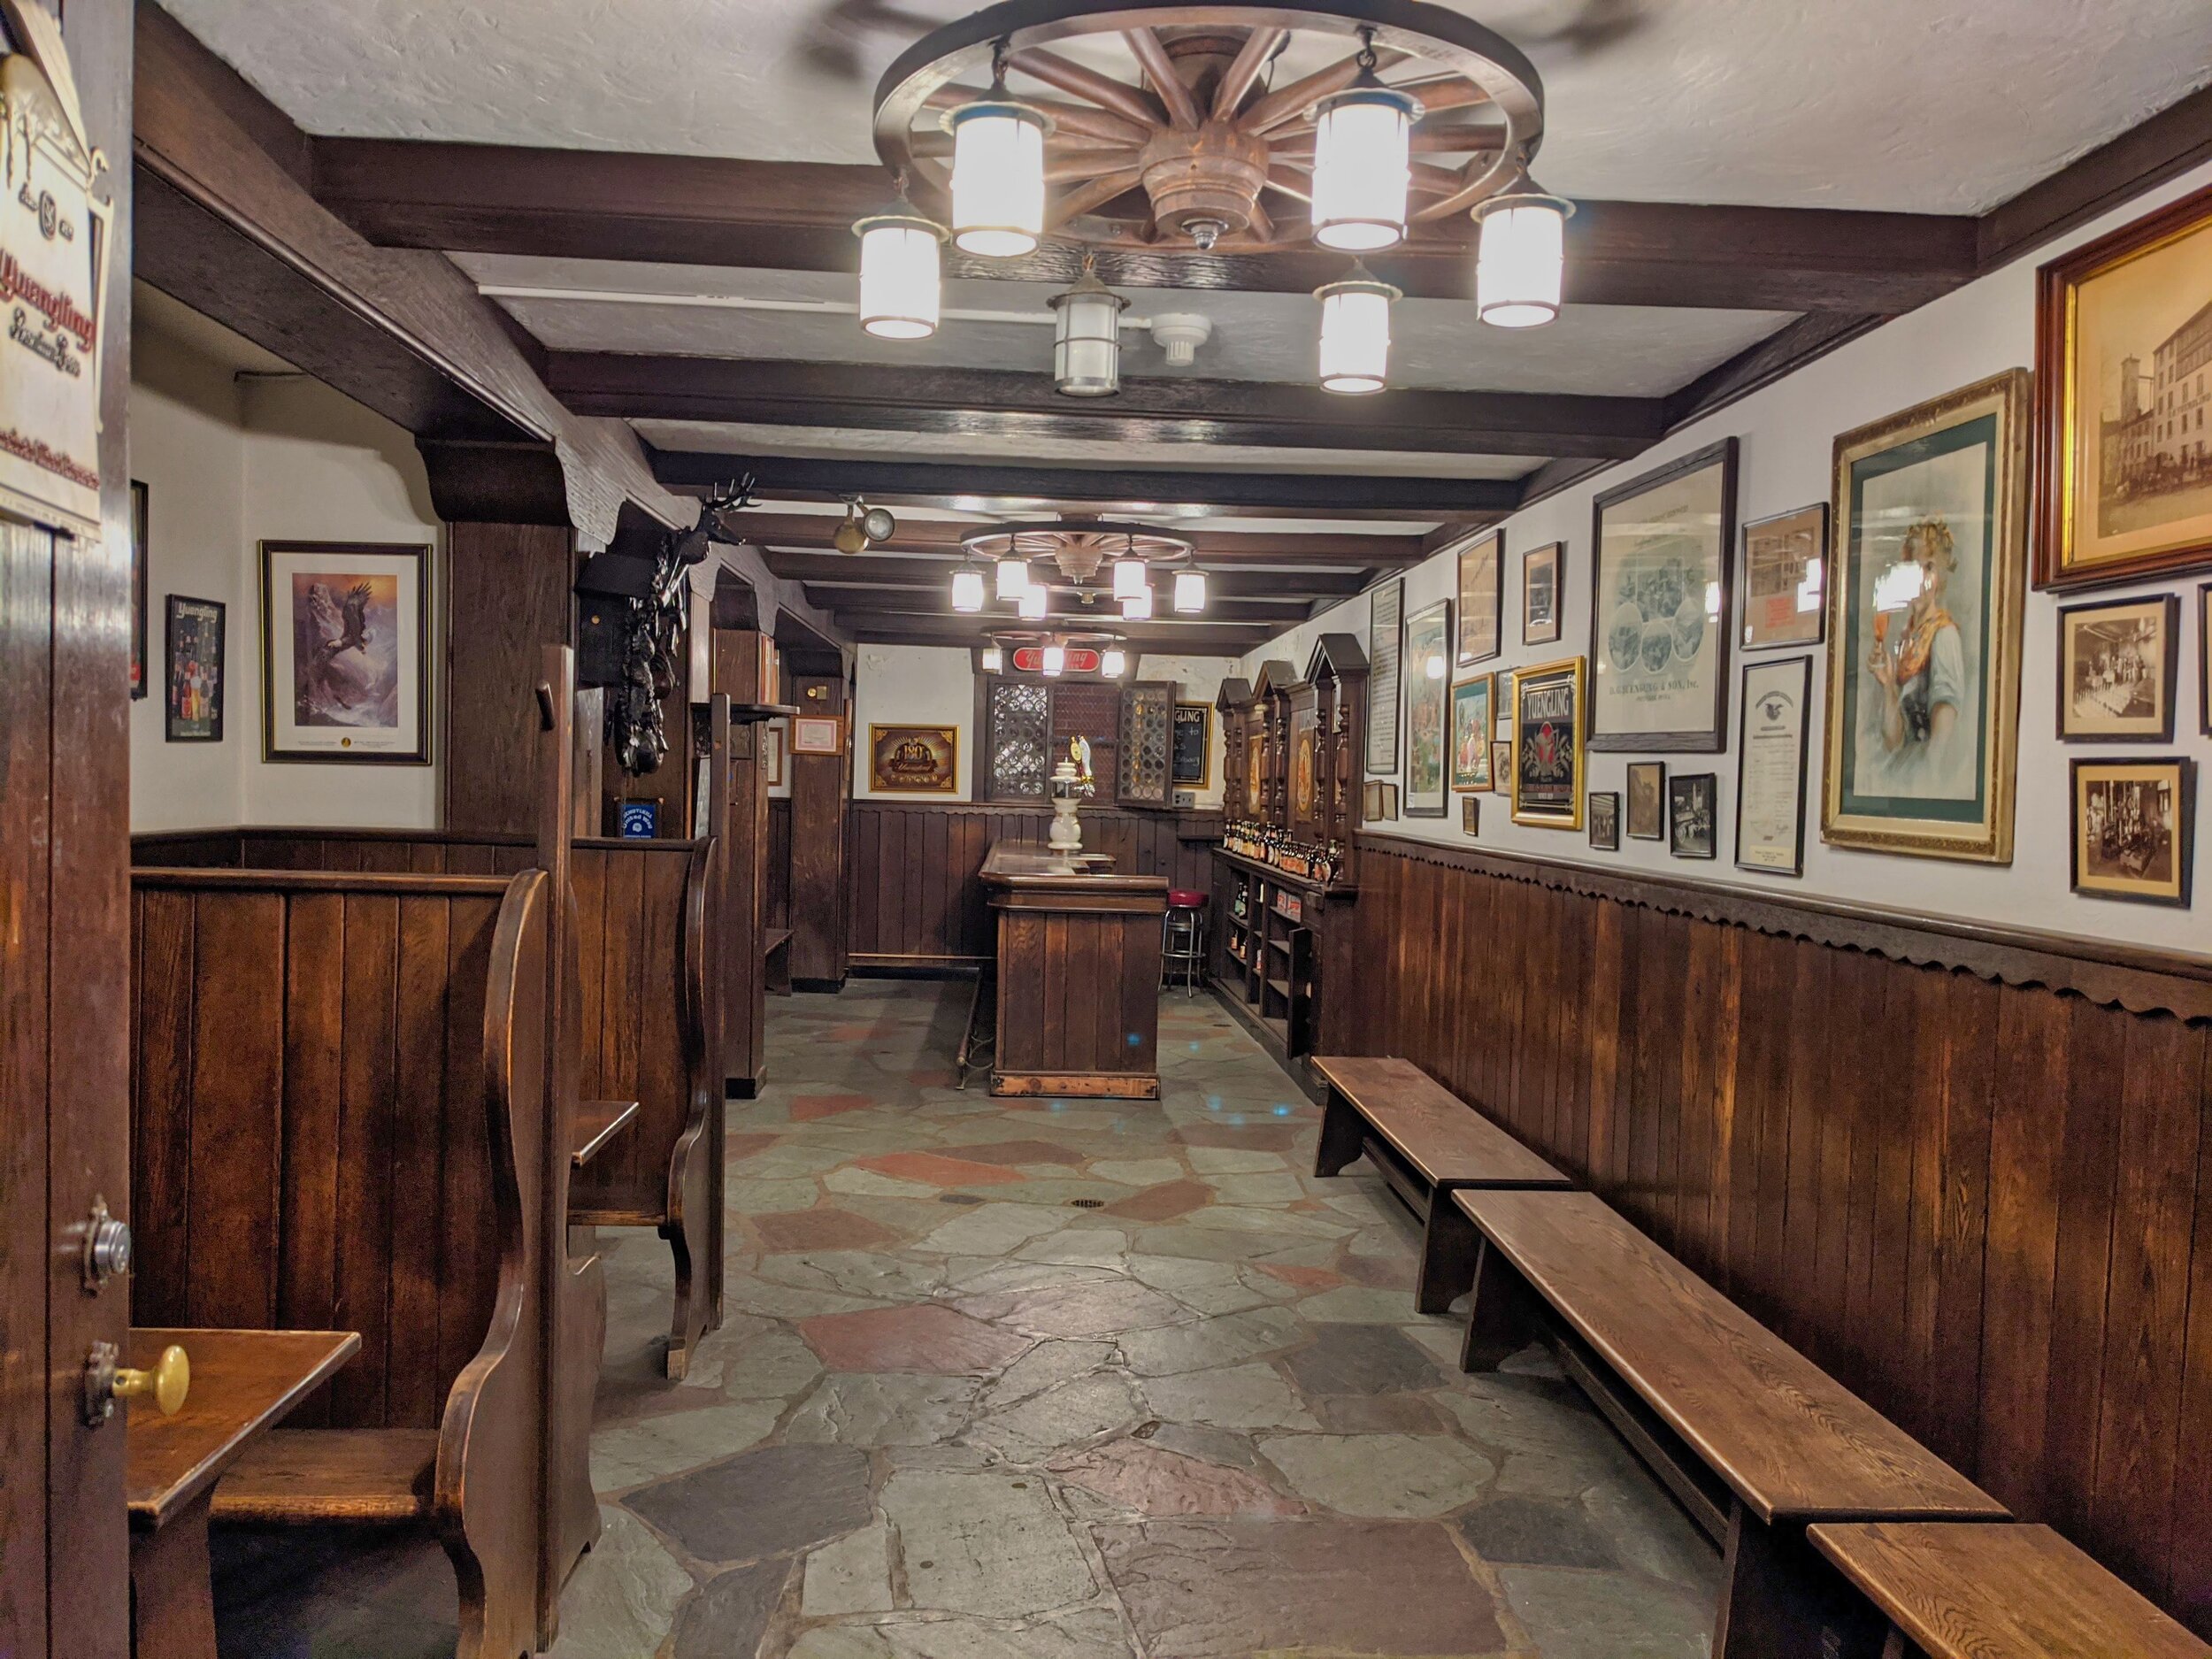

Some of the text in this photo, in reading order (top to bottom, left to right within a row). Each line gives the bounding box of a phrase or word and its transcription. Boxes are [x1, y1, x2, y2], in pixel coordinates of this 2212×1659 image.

[0, 249, 95, 352] Yuengling
[177, 602, 219, 624] Yuengling
[1174, 710, 1200, 723] GLING
[1527, 687, 1570, 720] YUENGLING
